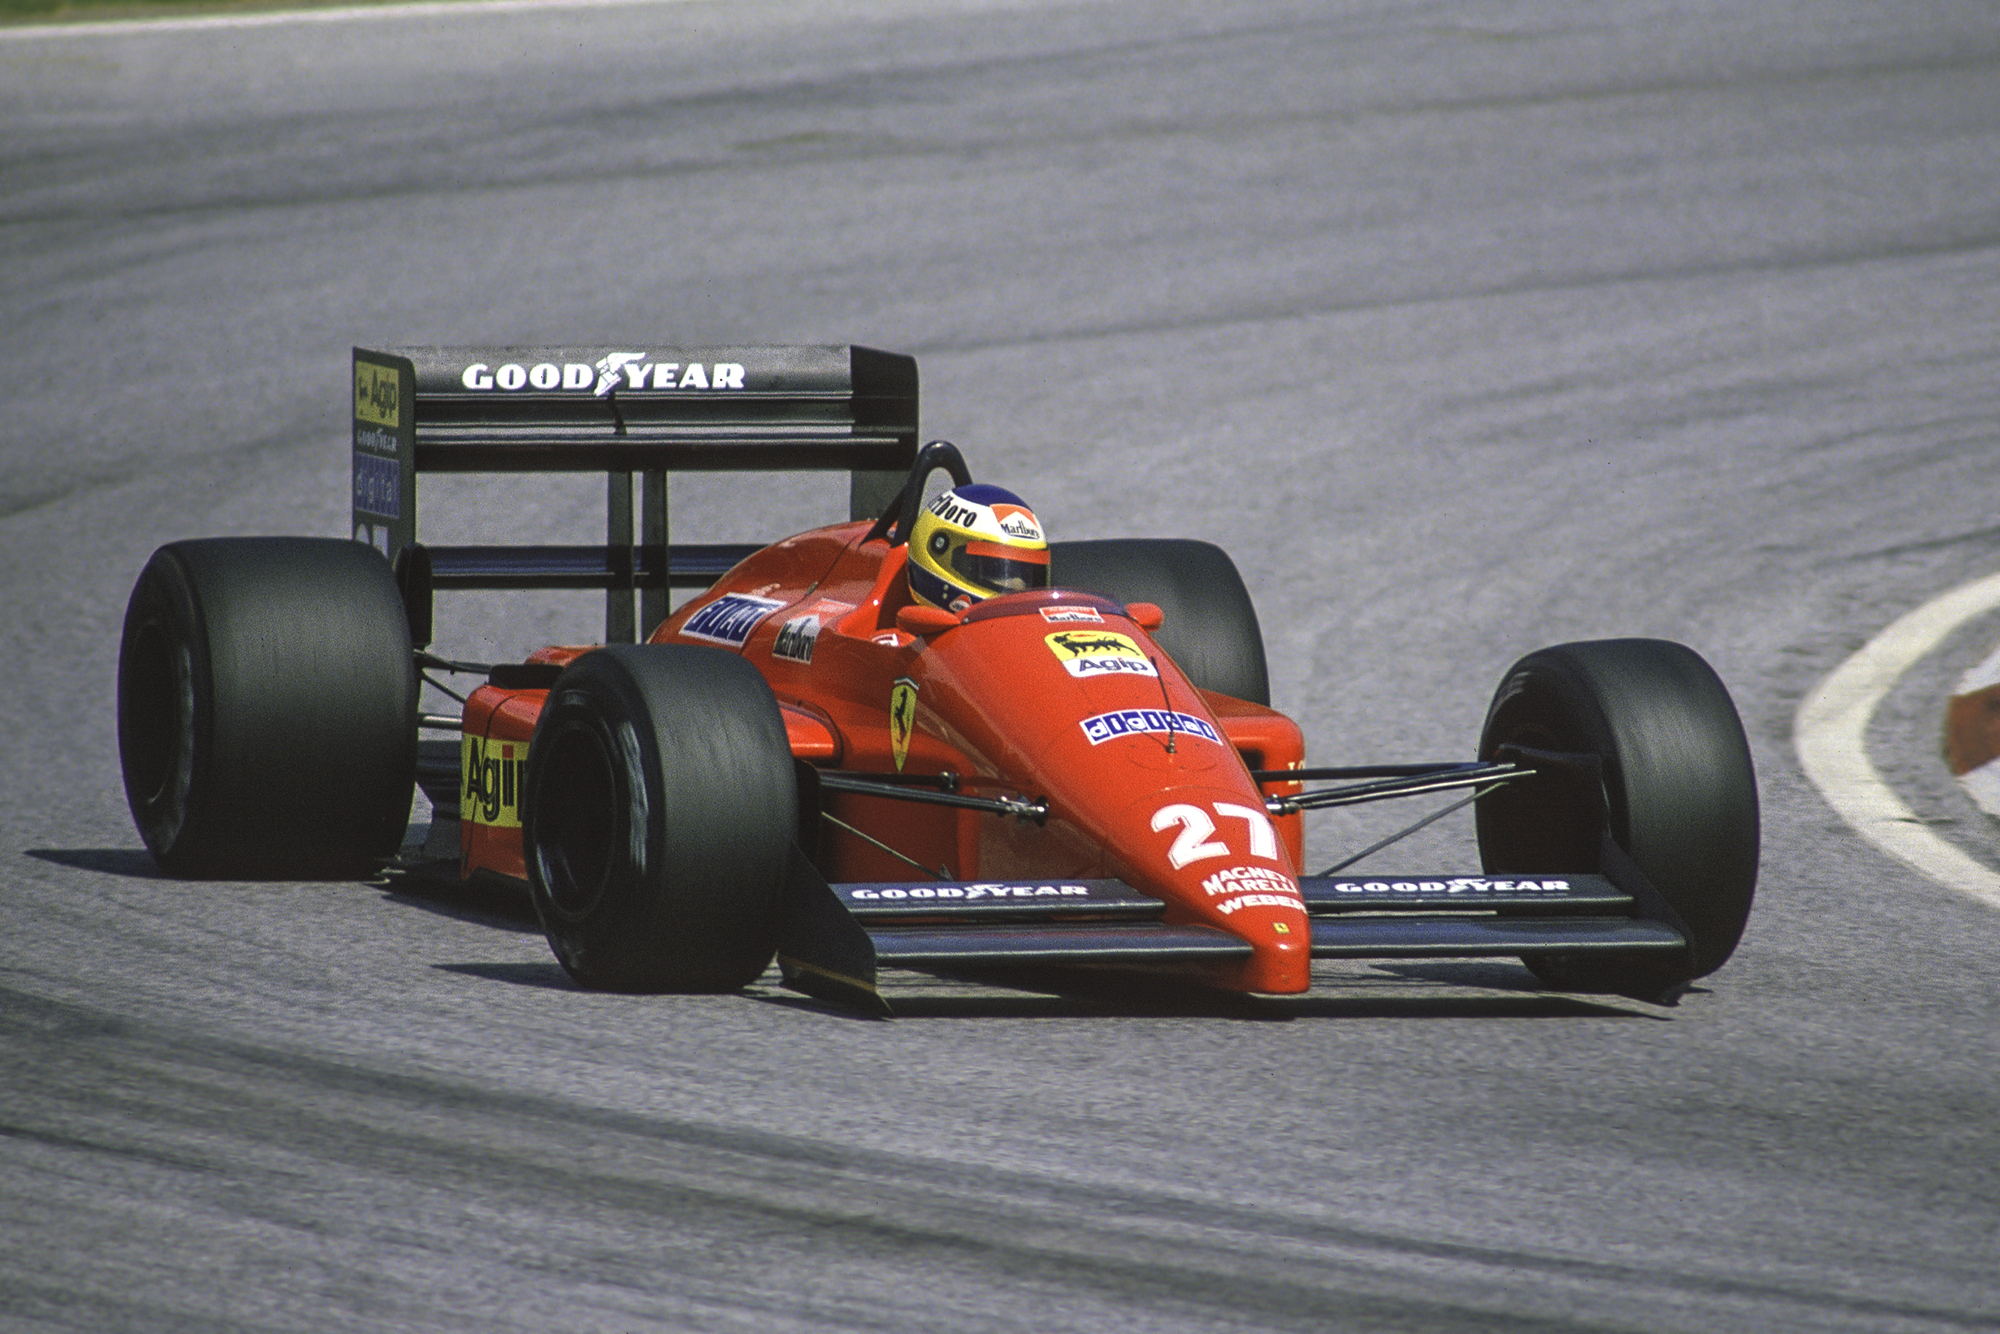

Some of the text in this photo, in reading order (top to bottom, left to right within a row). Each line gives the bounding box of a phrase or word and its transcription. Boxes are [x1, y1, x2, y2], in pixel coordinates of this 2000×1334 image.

[370, 369, 397, 419] Agip
[692, 600, 768, 633] FIAT
[773, 618, 816, 662] Marlboro
[1079, 657, 1148, 671] Agip
[1086, 713, 1215, 739] digital
[1150, 802, 1278, 871] 27
[1216, 894, 1308, 915] WEBER
